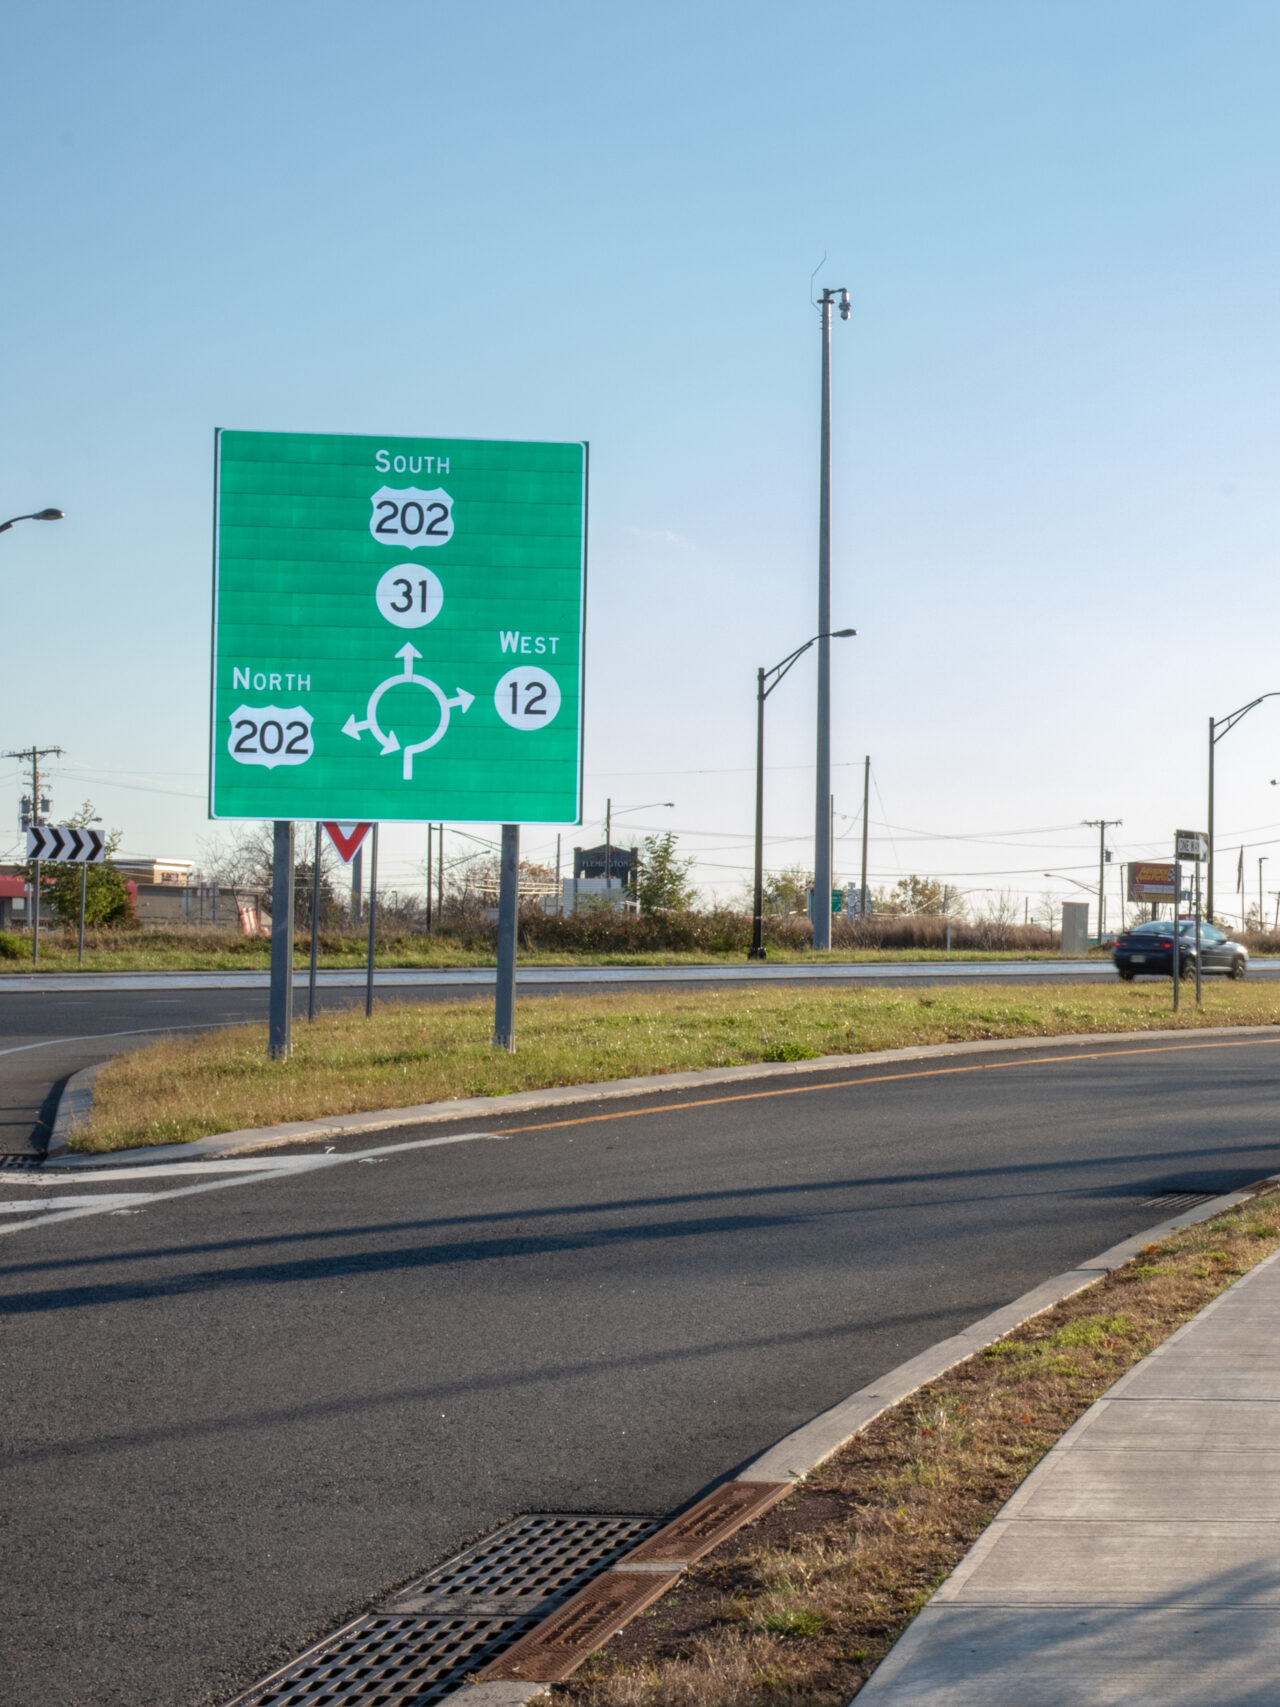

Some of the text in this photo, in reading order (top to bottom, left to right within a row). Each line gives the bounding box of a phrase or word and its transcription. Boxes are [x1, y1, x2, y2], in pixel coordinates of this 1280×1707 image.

[375, 449, 450, 474] SOUTH
[375, 500, 449, 536] 202
[390, 578, 427, 613] 31
[500, 630, 560, 654] WEST
[233, 667, 311, 691] NORTH
[509, 681, 547, 715] 12
[234, 719, 309, 754] 202
